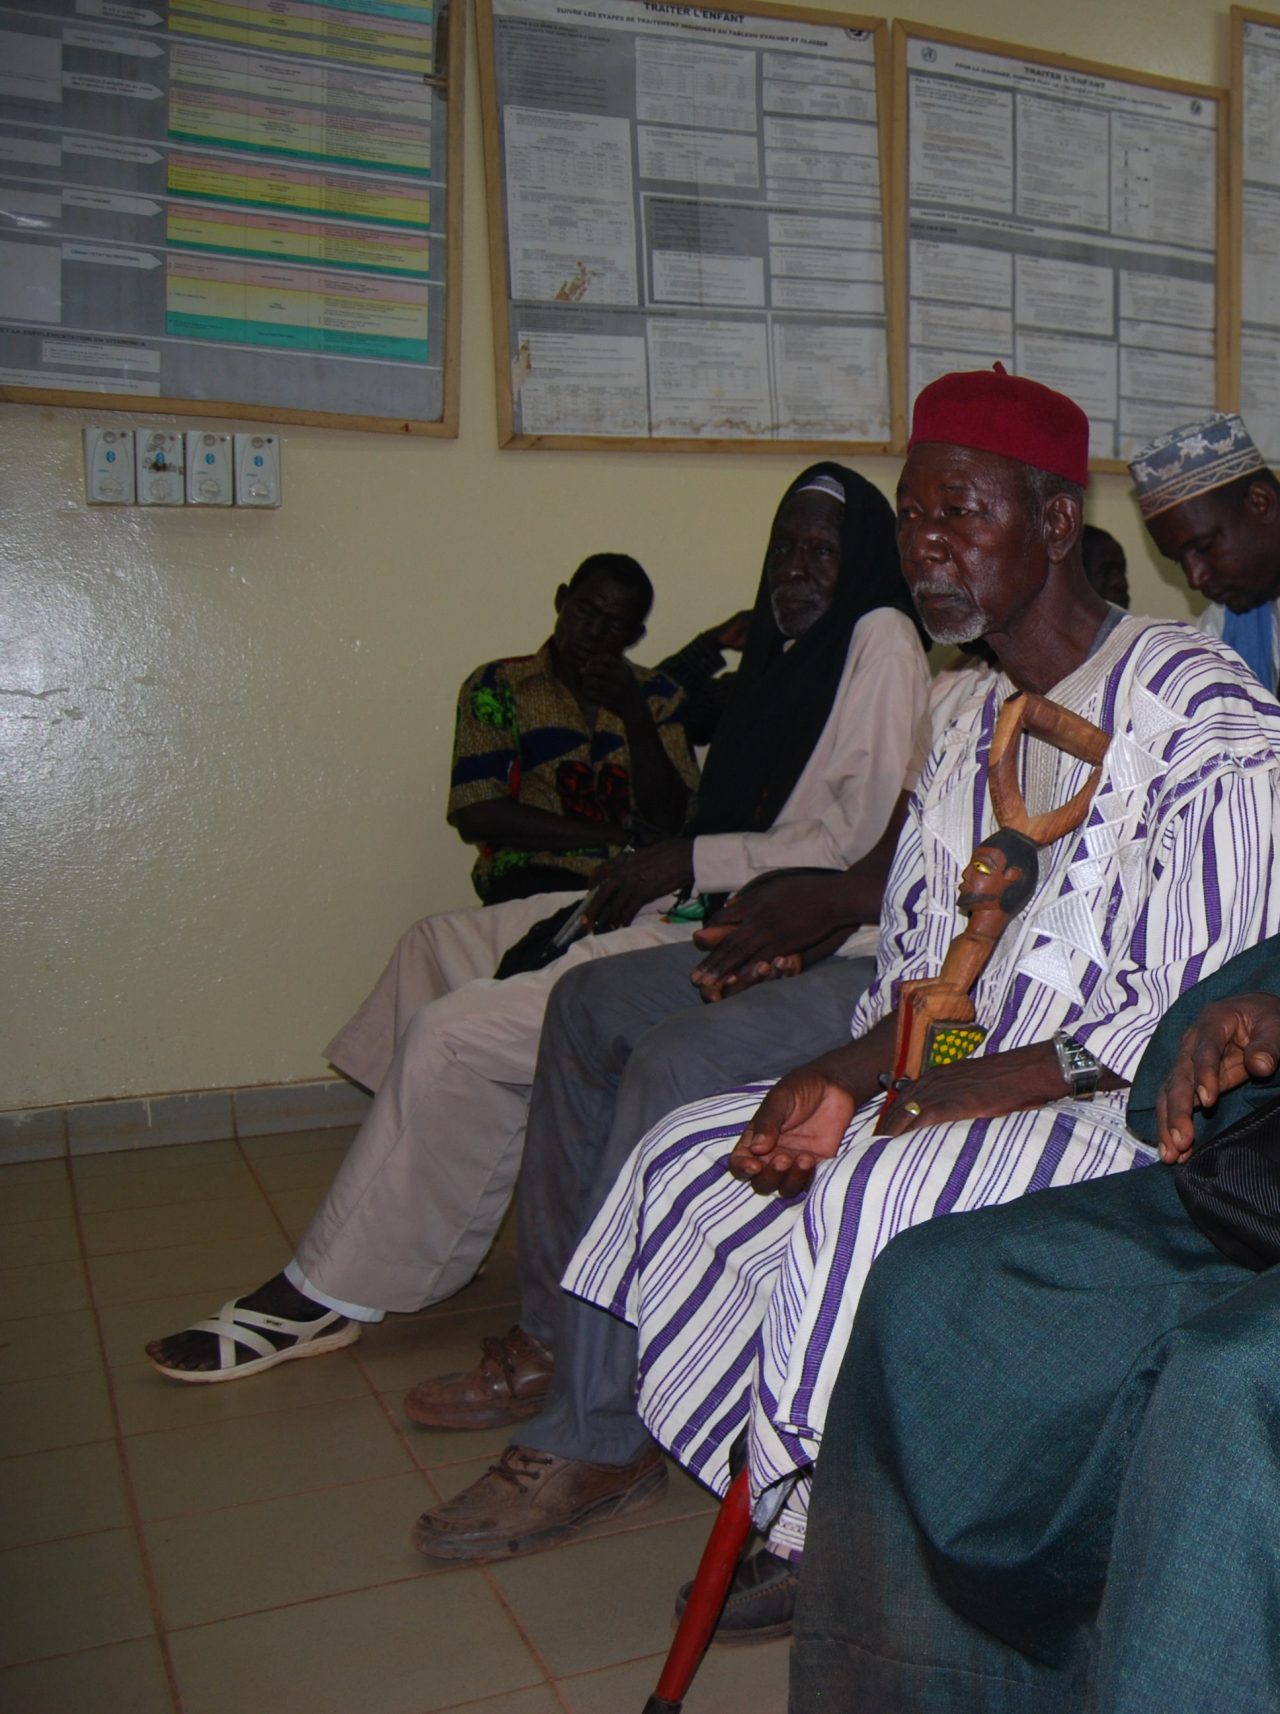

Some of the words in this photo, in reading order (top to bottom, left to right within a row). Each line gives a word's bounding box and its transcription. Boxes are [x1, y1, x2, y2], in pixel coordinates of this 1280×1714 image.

[584, 10, 597, 19] LES
[644, 2, 691, 17] TRAITER
[693, 9, 746, 24] L'ENFANT
[1024, 66, 1061, 81] TRAITER
